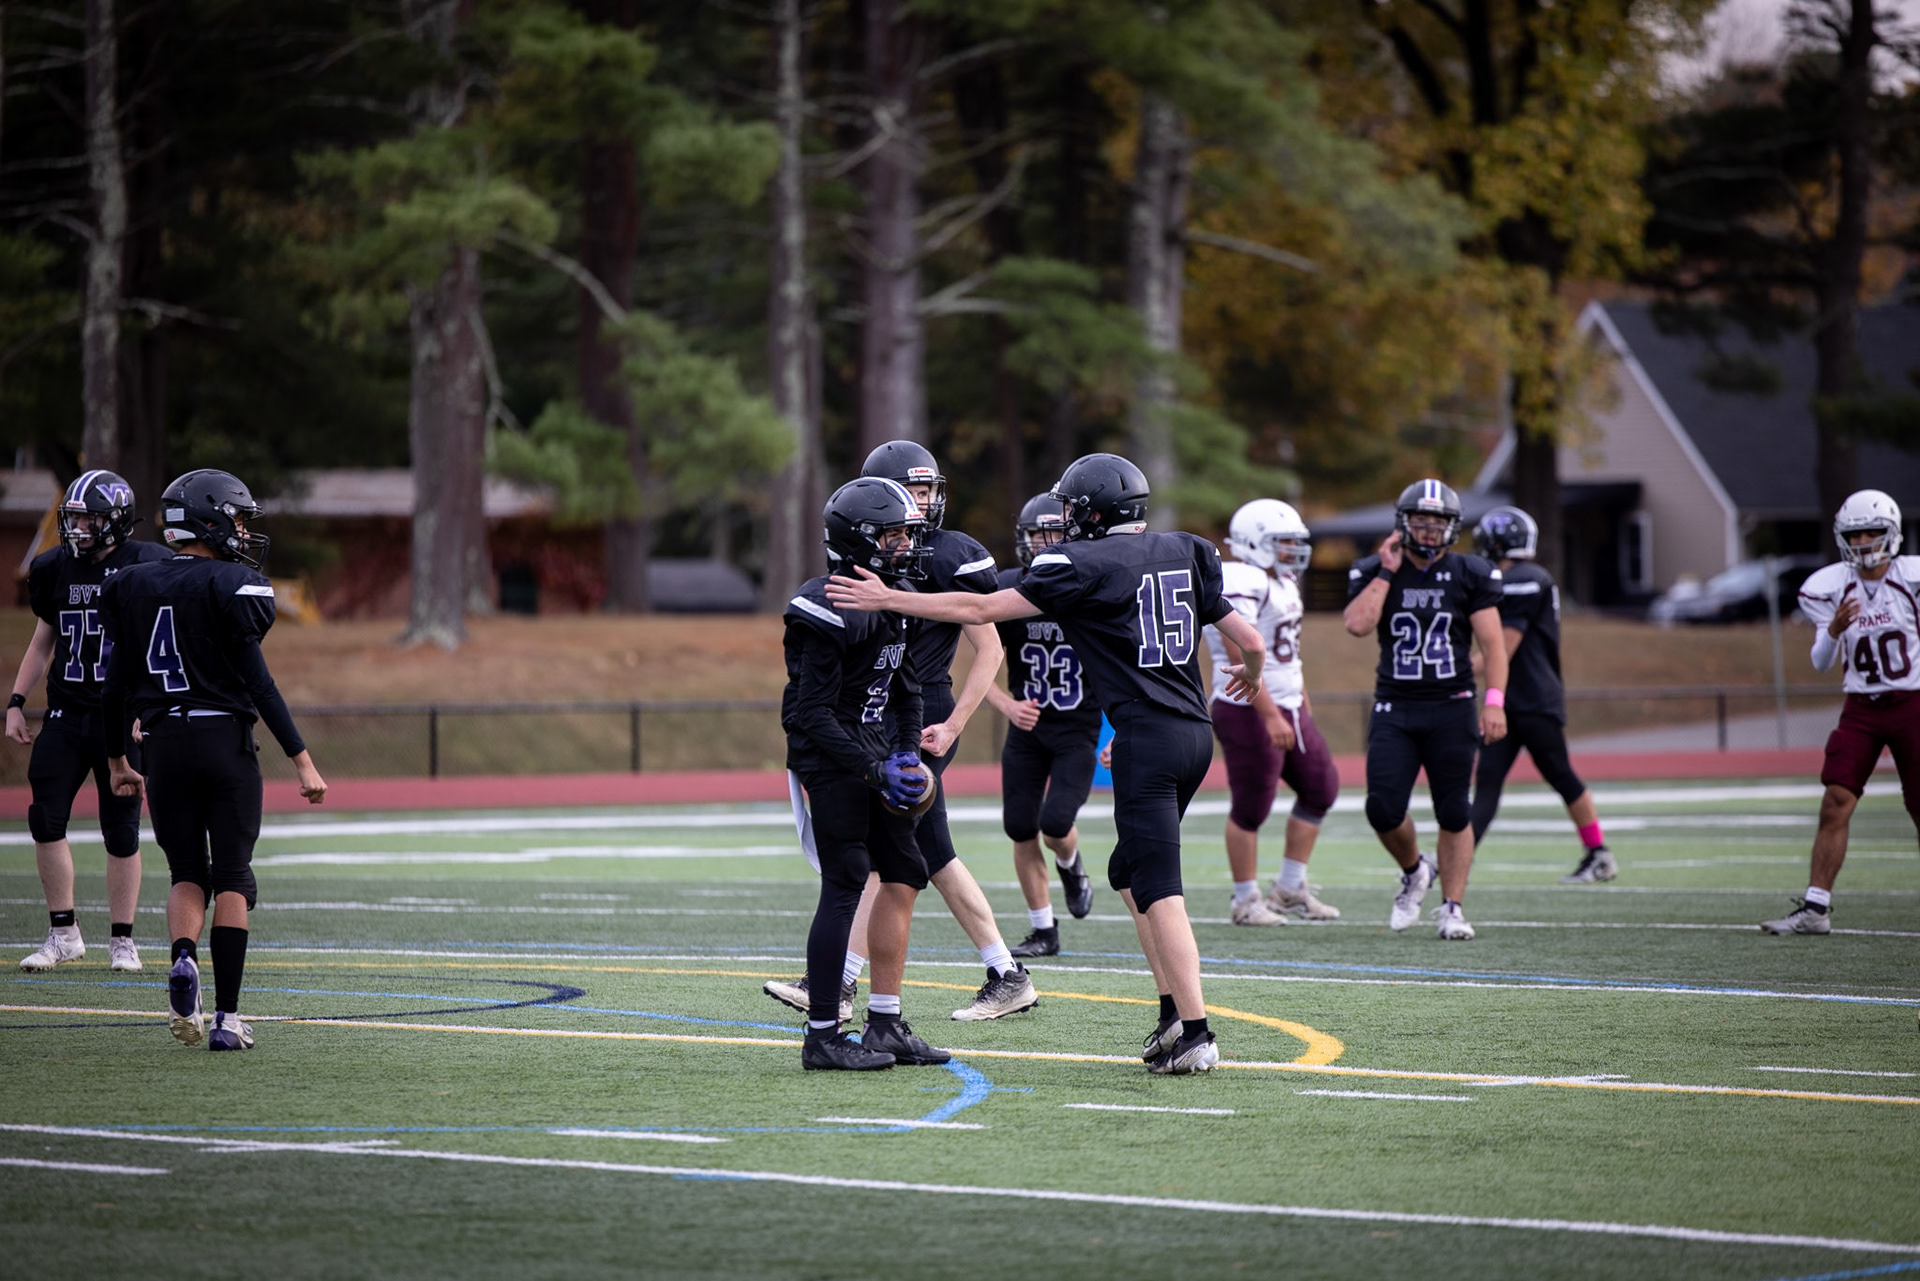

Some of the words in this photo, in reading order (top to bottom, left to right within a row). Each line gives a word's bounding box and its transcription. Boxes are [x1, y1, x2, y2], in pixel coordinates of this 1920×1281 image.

[1136, 569, 1195, 668] 15
[1402, 588, 1445, 609] BVT
[1858, 611, 1891, 629] RAMS
[60, 610, 114, 682] 77
[146, 605, 190, 692] 4
[1020, 643, 1084, 712] 33
[1390, 611, 1457, 681] 24
[1854, 630, 1911, 684] 40
